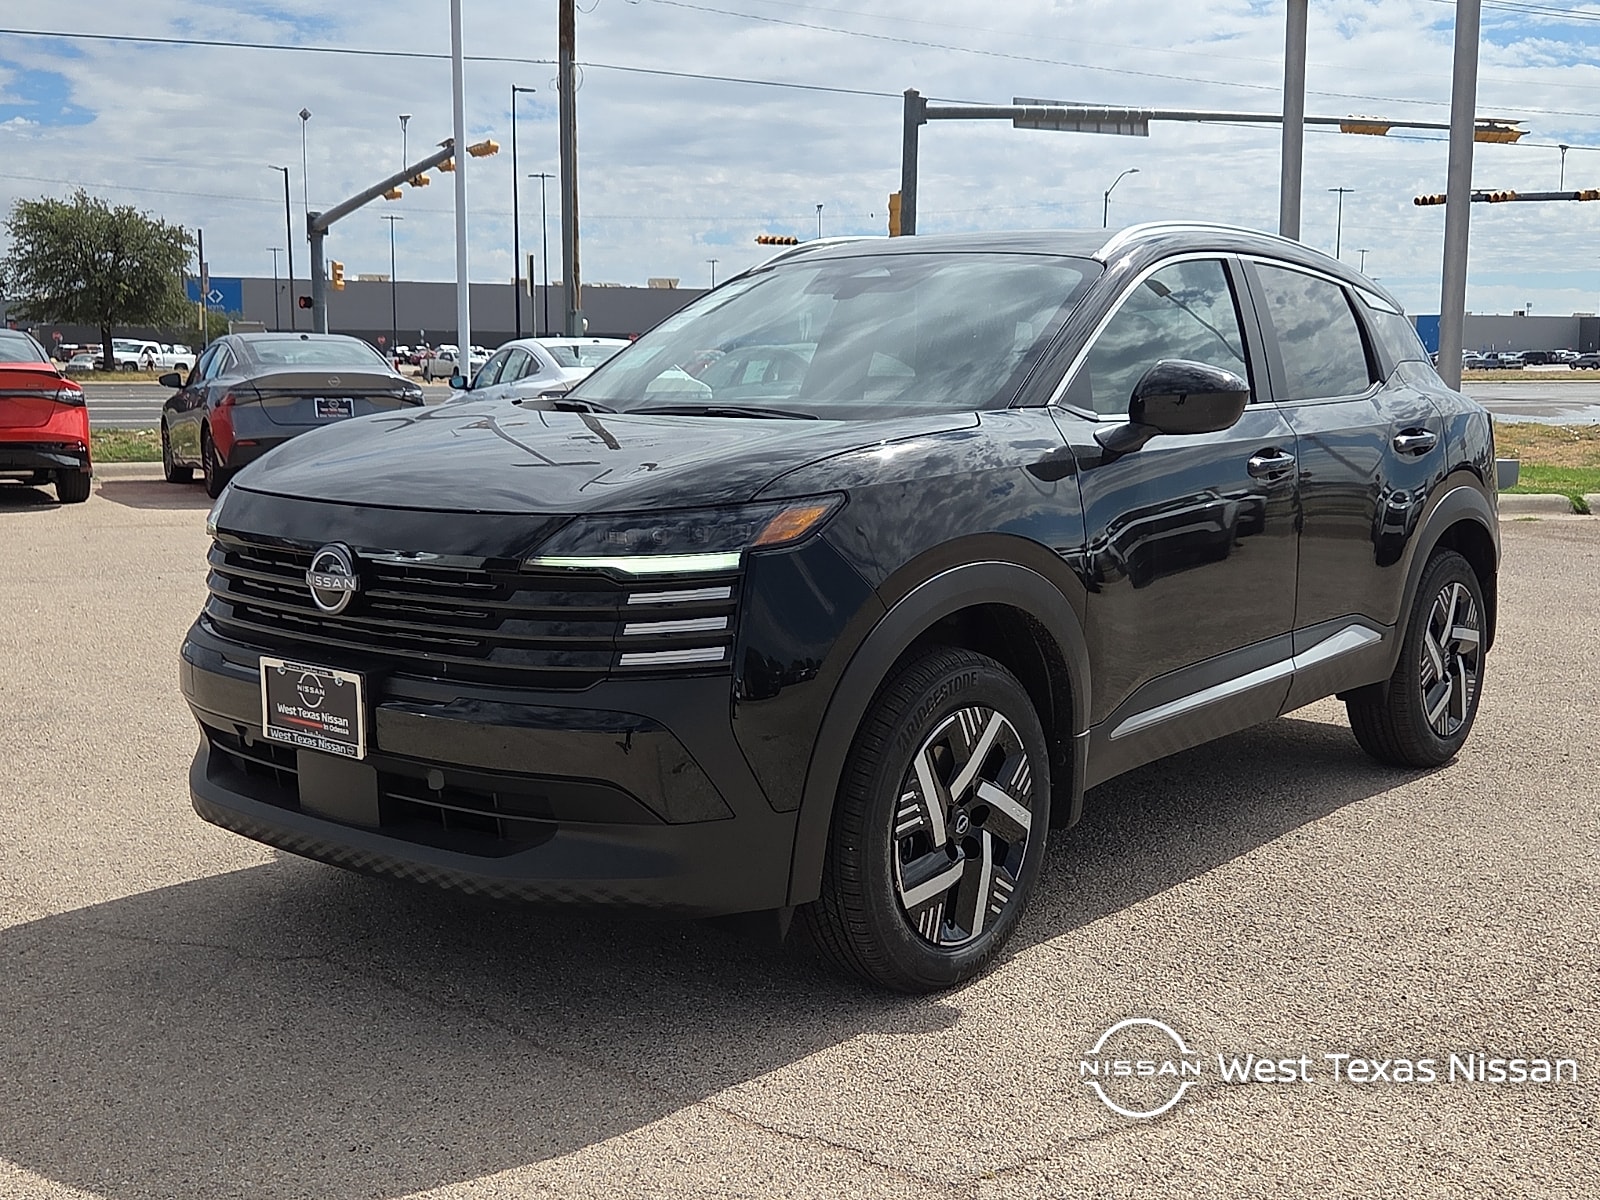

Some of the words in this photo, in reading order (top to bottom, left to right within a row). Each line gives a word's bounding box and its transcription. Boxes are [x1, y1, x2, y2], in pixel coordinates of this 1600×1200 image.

[306, 573, 355, 589] NISSAN
[297, 684, 325, 696] NISSAN
[277, 703, 297, 716] West
[297, 707, 321, 721] Texas
[321, 712, 349, 727] Nissan
[898, 671, 978, 754] BRIDGESTONE
[270, 729, 292, 741] West
[293, 733, 317, 746] Texas
[318, 739, 346, 754] Nissan
